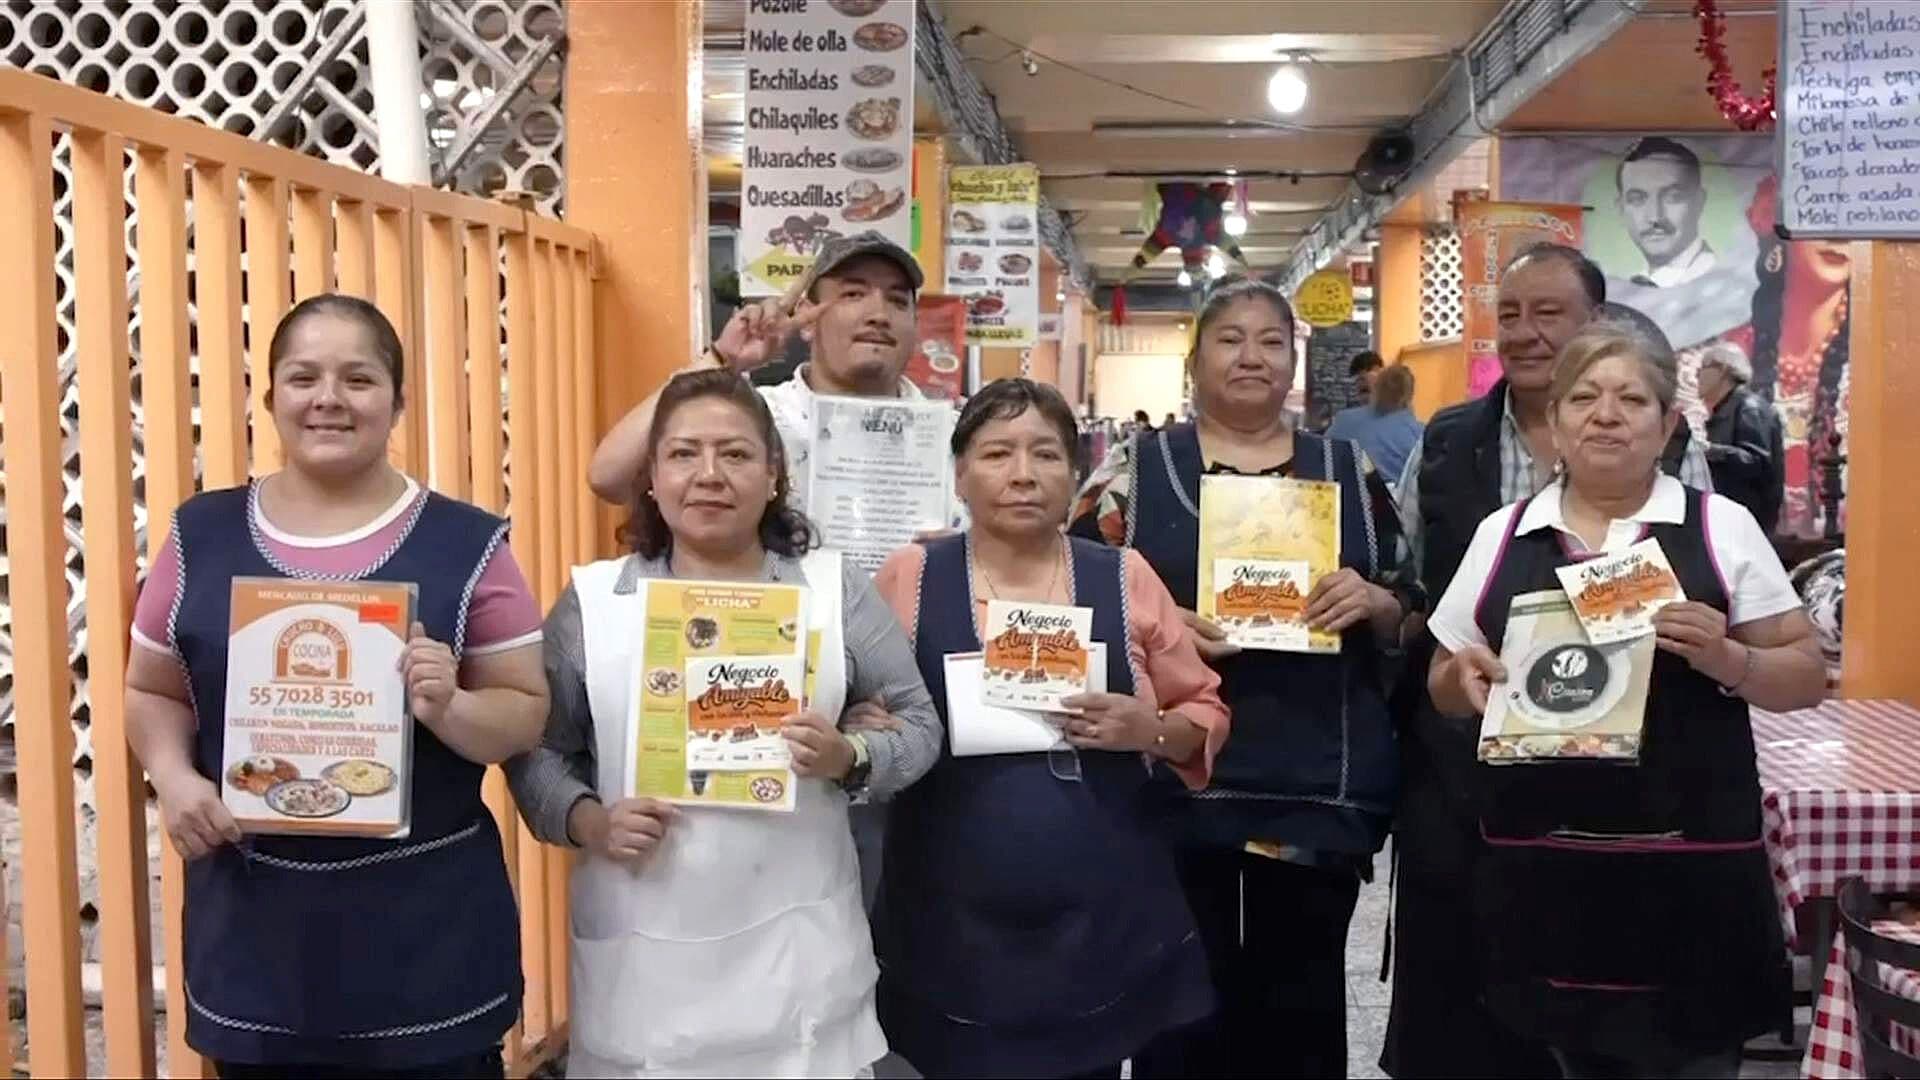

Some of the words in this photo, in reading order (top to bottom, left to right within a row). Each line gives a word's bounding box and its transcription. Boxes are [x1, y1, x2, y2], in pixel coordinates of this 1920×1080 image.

[1799, 7, 1920, 40] Enchiladas
[749, 30, 788, 51] Mole
[793, 31, 813, 51] de
[818, 31, 847, 51] olla
[1800, 40, 1914, 64] Enchiladas
[749, 69, 839, 91] Enchiladas
[1795, 63, 1873, 96] Pechuga
[1889, 90, 1909, 106] de
[748, 107, 839, 135] Chilaquiles
[1853, 111, 1909, 130] relleno
[1847, 135, 1867, 152] de
[747, 146, 837, 168] Huaraches
[1792, 162, 1849, 181] Tacos
[1856, 157, 1920, 176] dorado
[747, 185, 844, 208] Quesadillas
[1795, 184, 1850, 207] Carne
[1858, 182, 1914, 202] asada
[1797, 204, 1839, 225] Mole
[1233, 565, 1292, 585] Negocio
[1006, 609, 1073, 631] Negocio
[707, 663, 780, 688] Negocio
[249, 686, 272, 705] 55
[277, 684, 323, 706] 7028
[329, 689, 374, 709] 3501
[697, 679, 790, 711] Amigable
[290, 709, 355, 719] TEMPORADA
